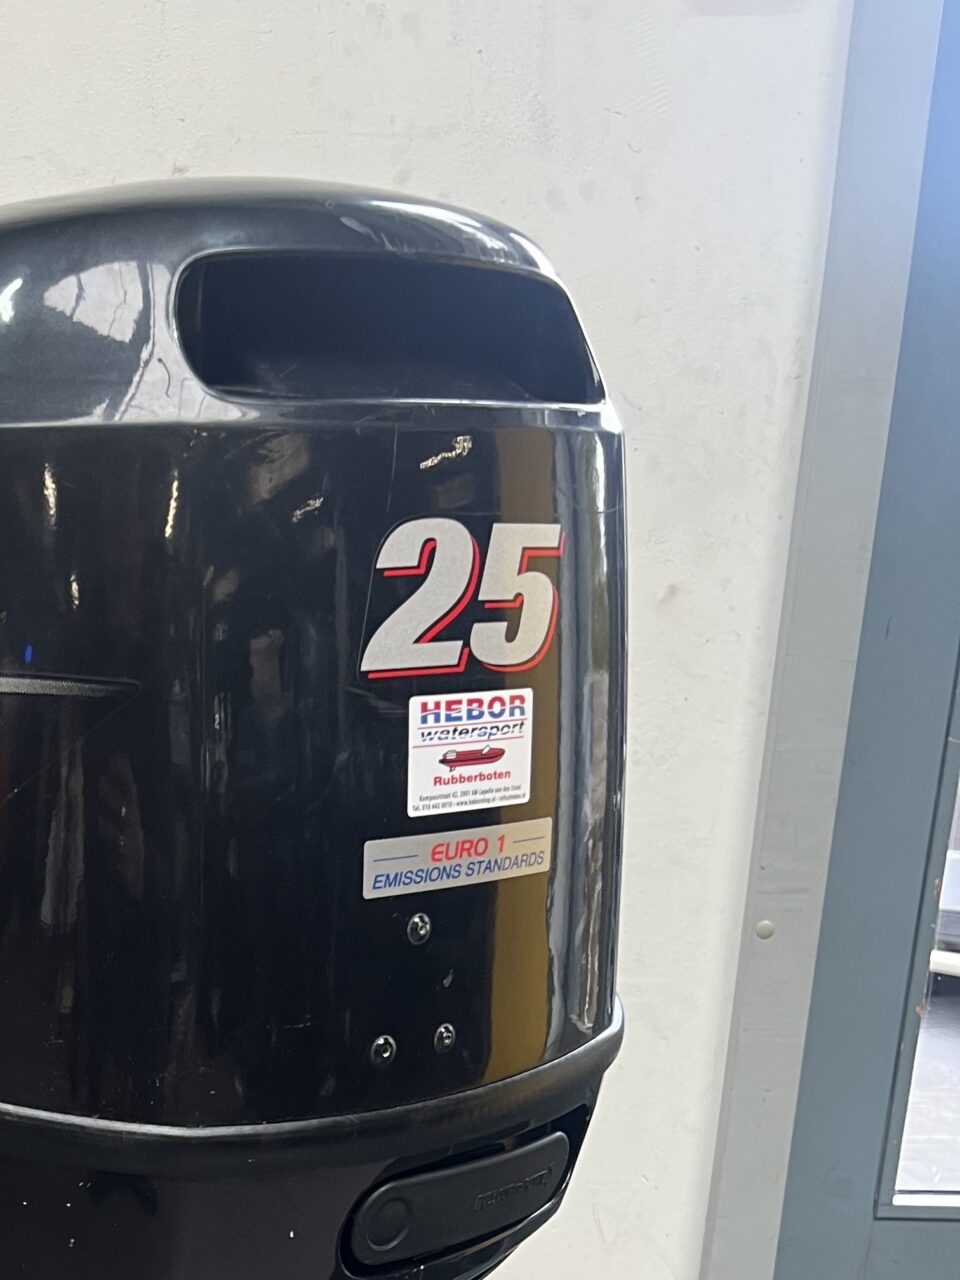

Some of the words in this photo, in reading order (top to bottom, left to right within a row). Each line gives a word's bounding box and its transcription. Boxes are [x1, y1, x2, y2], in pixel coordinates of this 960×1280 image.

[360, 517, 565, 679] 25
[420, 694, 526, 725] HEBOR
[420, 721, 526, 742] watersport
[433, 771, 511, 787] Rubberboten
[430, 837, 488, 862] EURO
[497, 834, 506, 854] 1
[372, 863, 461, 890] EMISSIONS
[465, 851, 545, 878] STANDARDS
